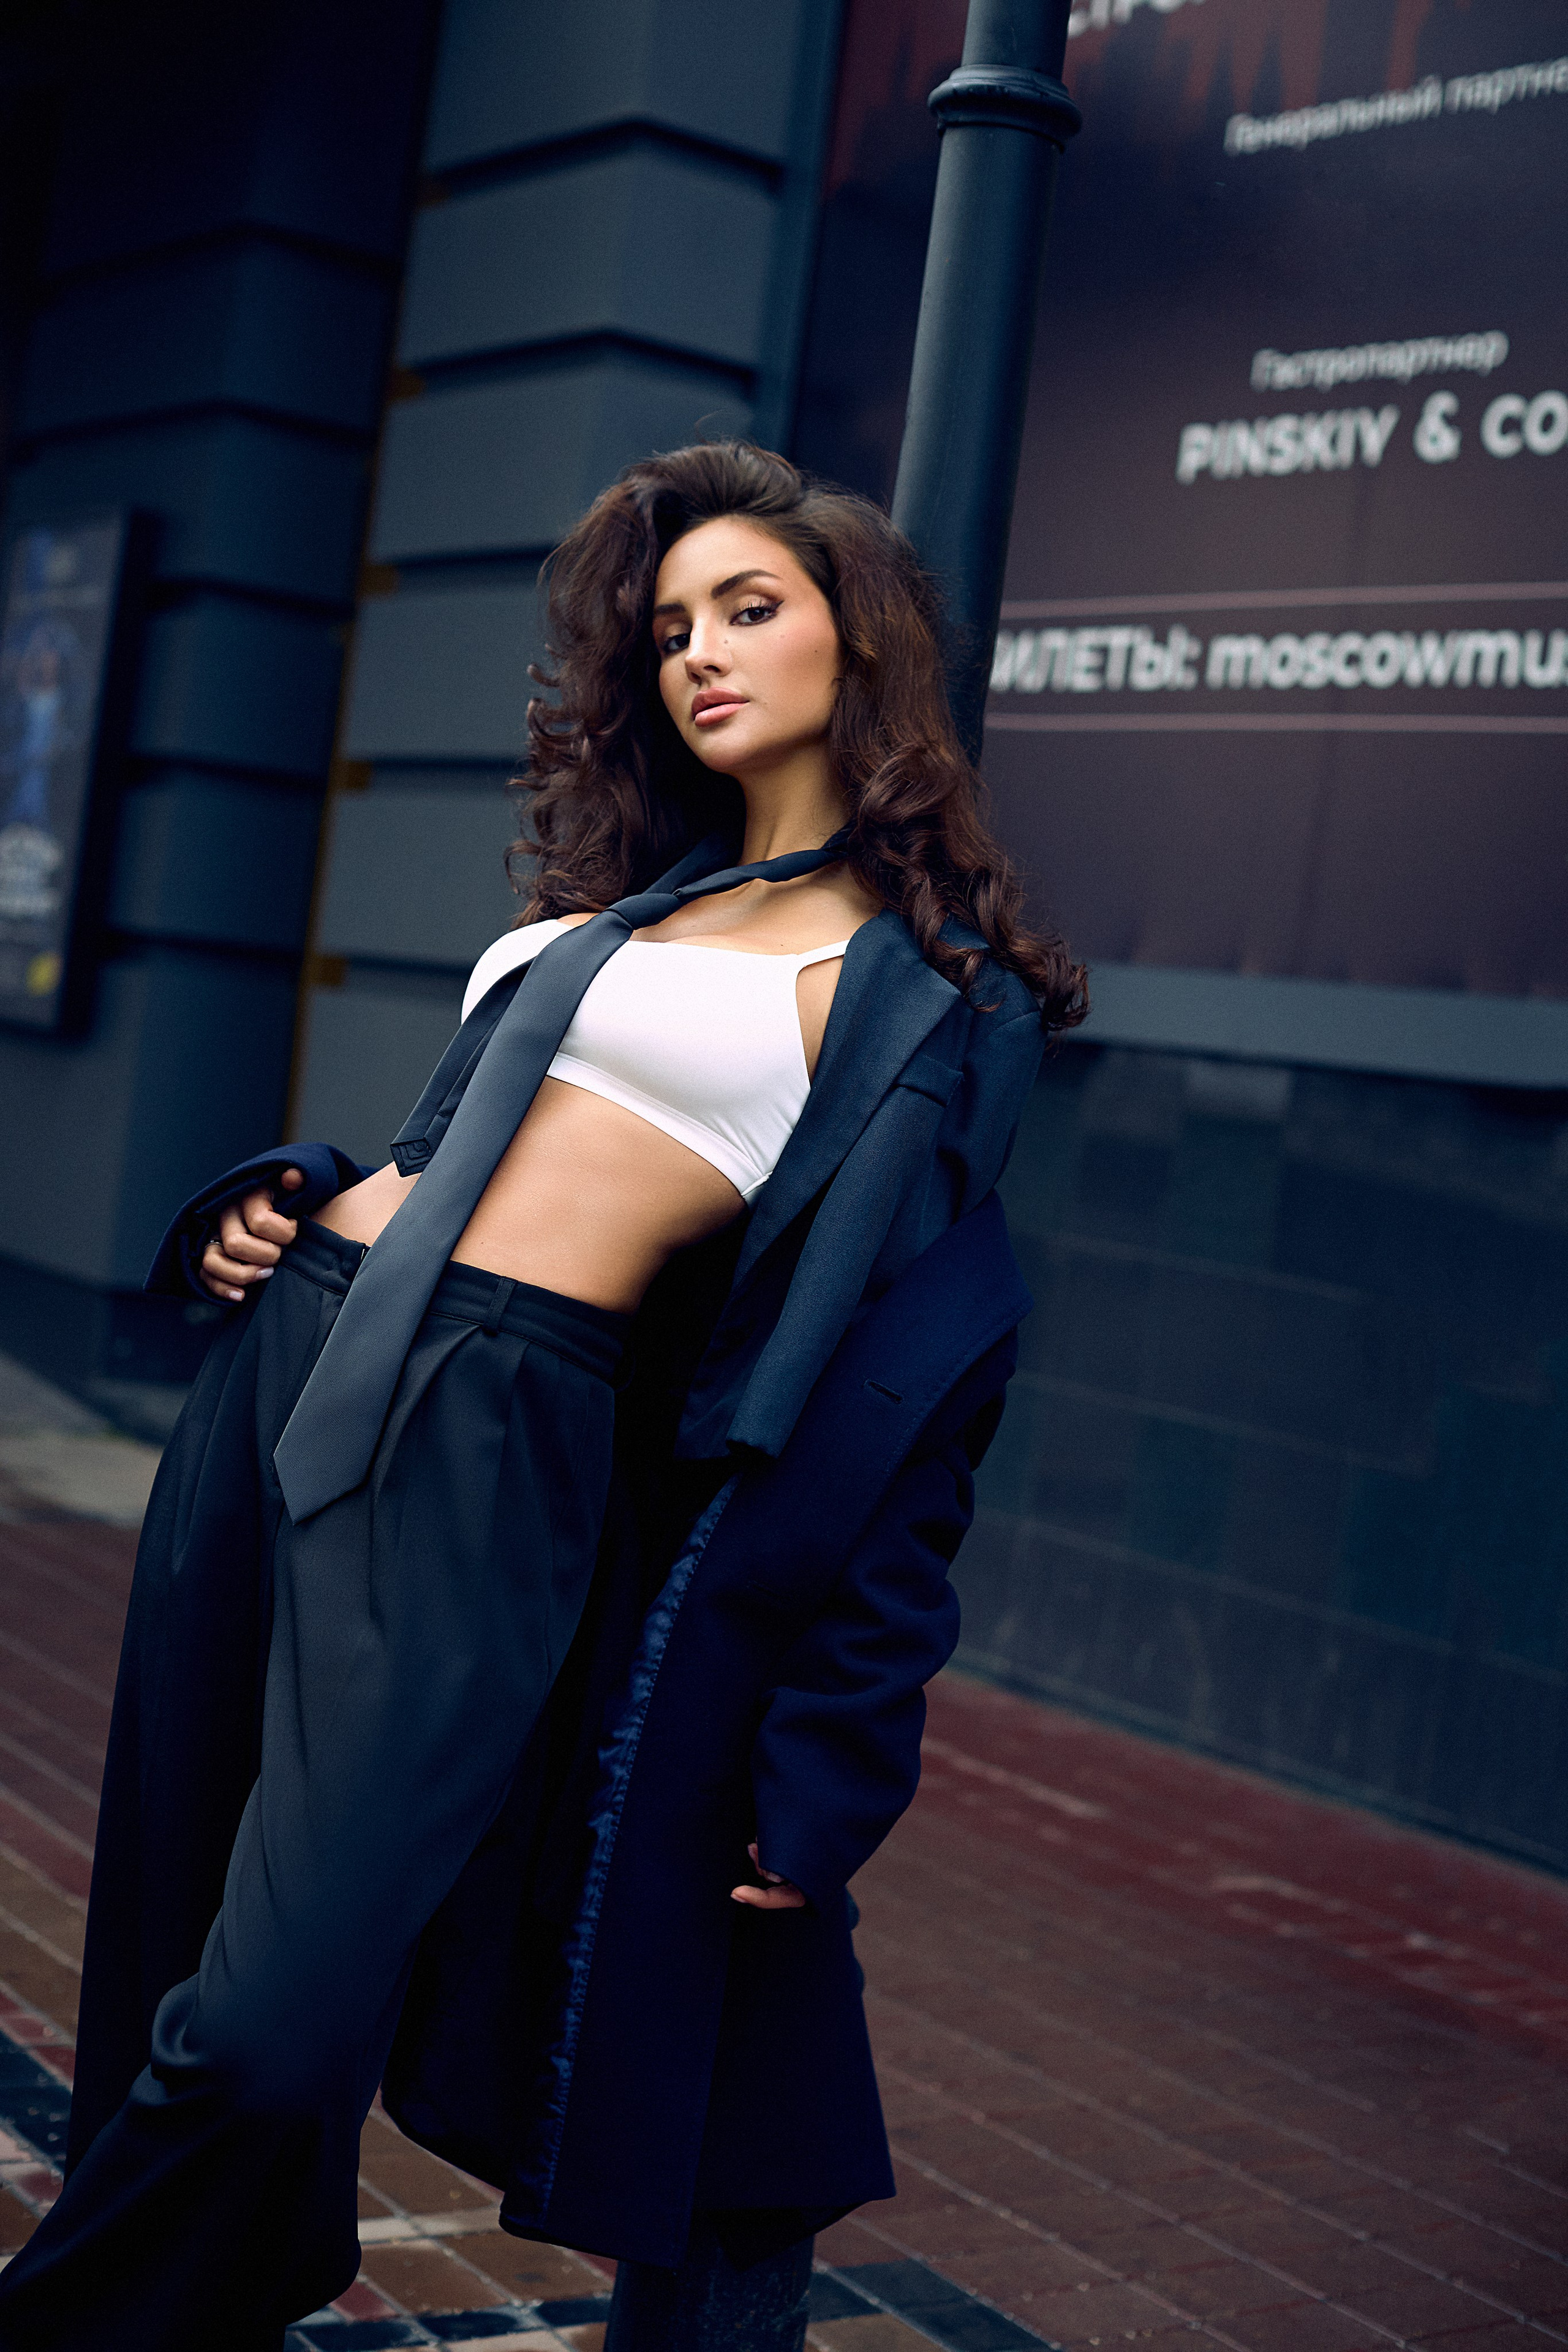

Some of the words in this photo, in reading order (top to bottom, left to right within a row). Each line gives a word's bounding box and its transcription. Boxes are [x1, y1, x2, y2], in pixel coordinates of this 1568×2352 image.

[1226, 75, 1443, 153] Генеральный
[1251, 331, 1509, 391] Гастропартнер
[1414, 391, 1460, 464] &
[989, 624, 1202, 693] ИЛЕТЫ:
[1205, 628, 1568, 690] moscowmu
